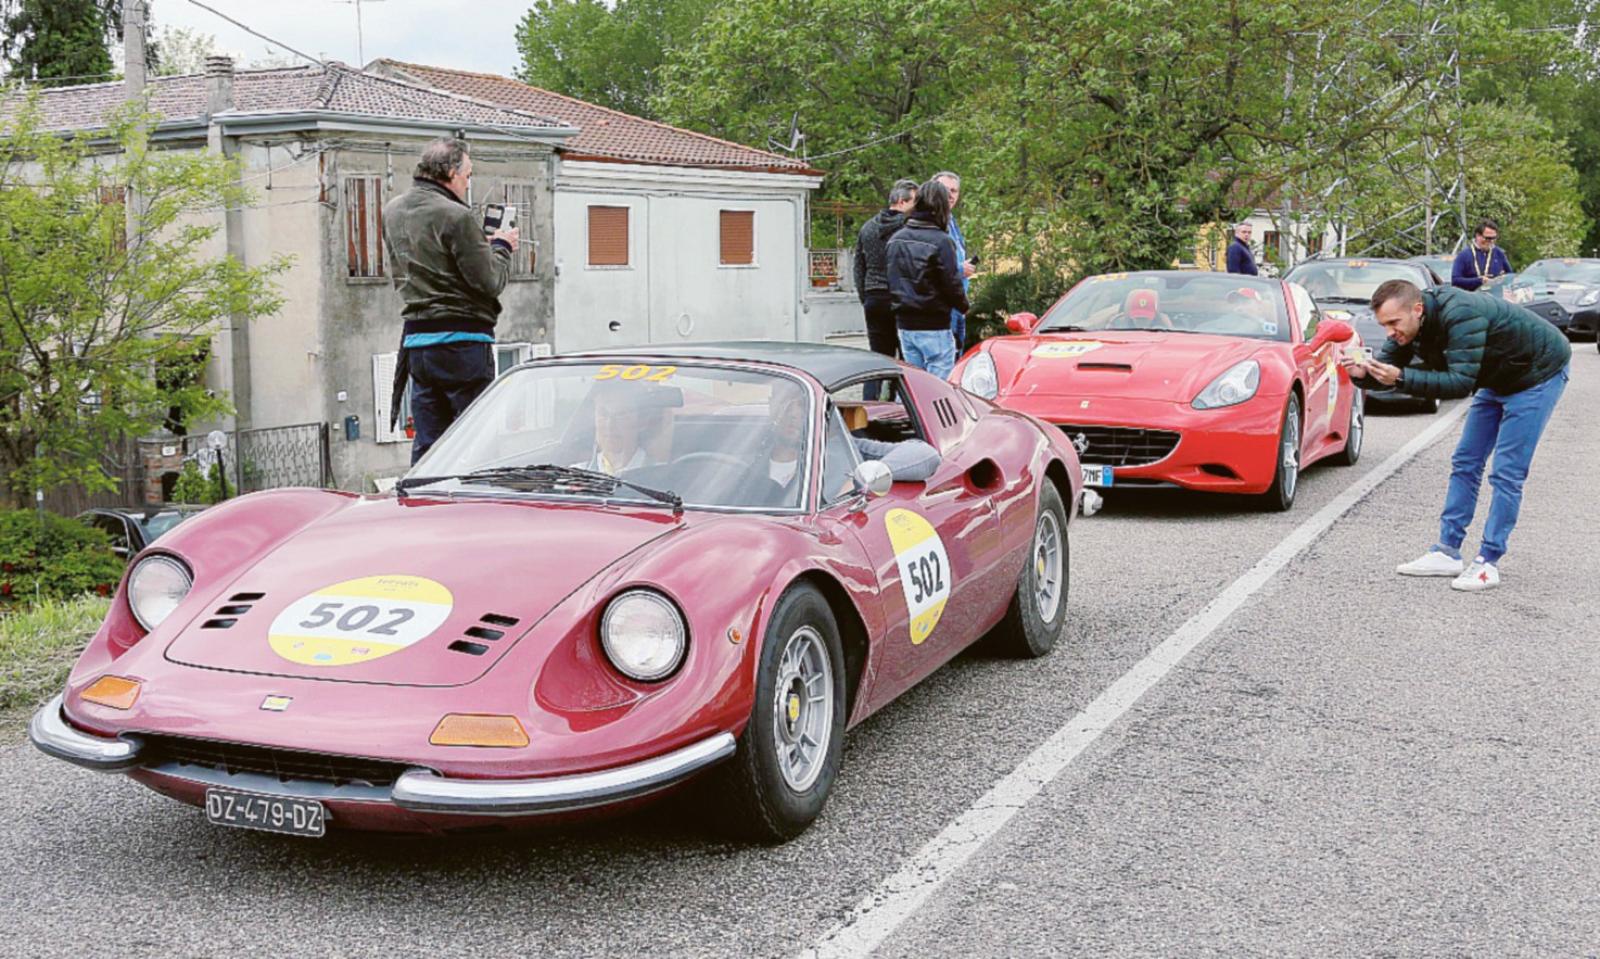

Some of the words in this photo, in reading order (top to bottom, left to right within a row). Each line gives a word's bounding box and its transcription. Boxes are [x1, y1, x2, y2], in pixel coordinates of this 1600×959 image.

[592, 364, 677, 381] 502
[907, 550, 944, 603] 502
[299, 602, 415, 636] 502
[209, 794, 320, 831] DZ-479-DZ
